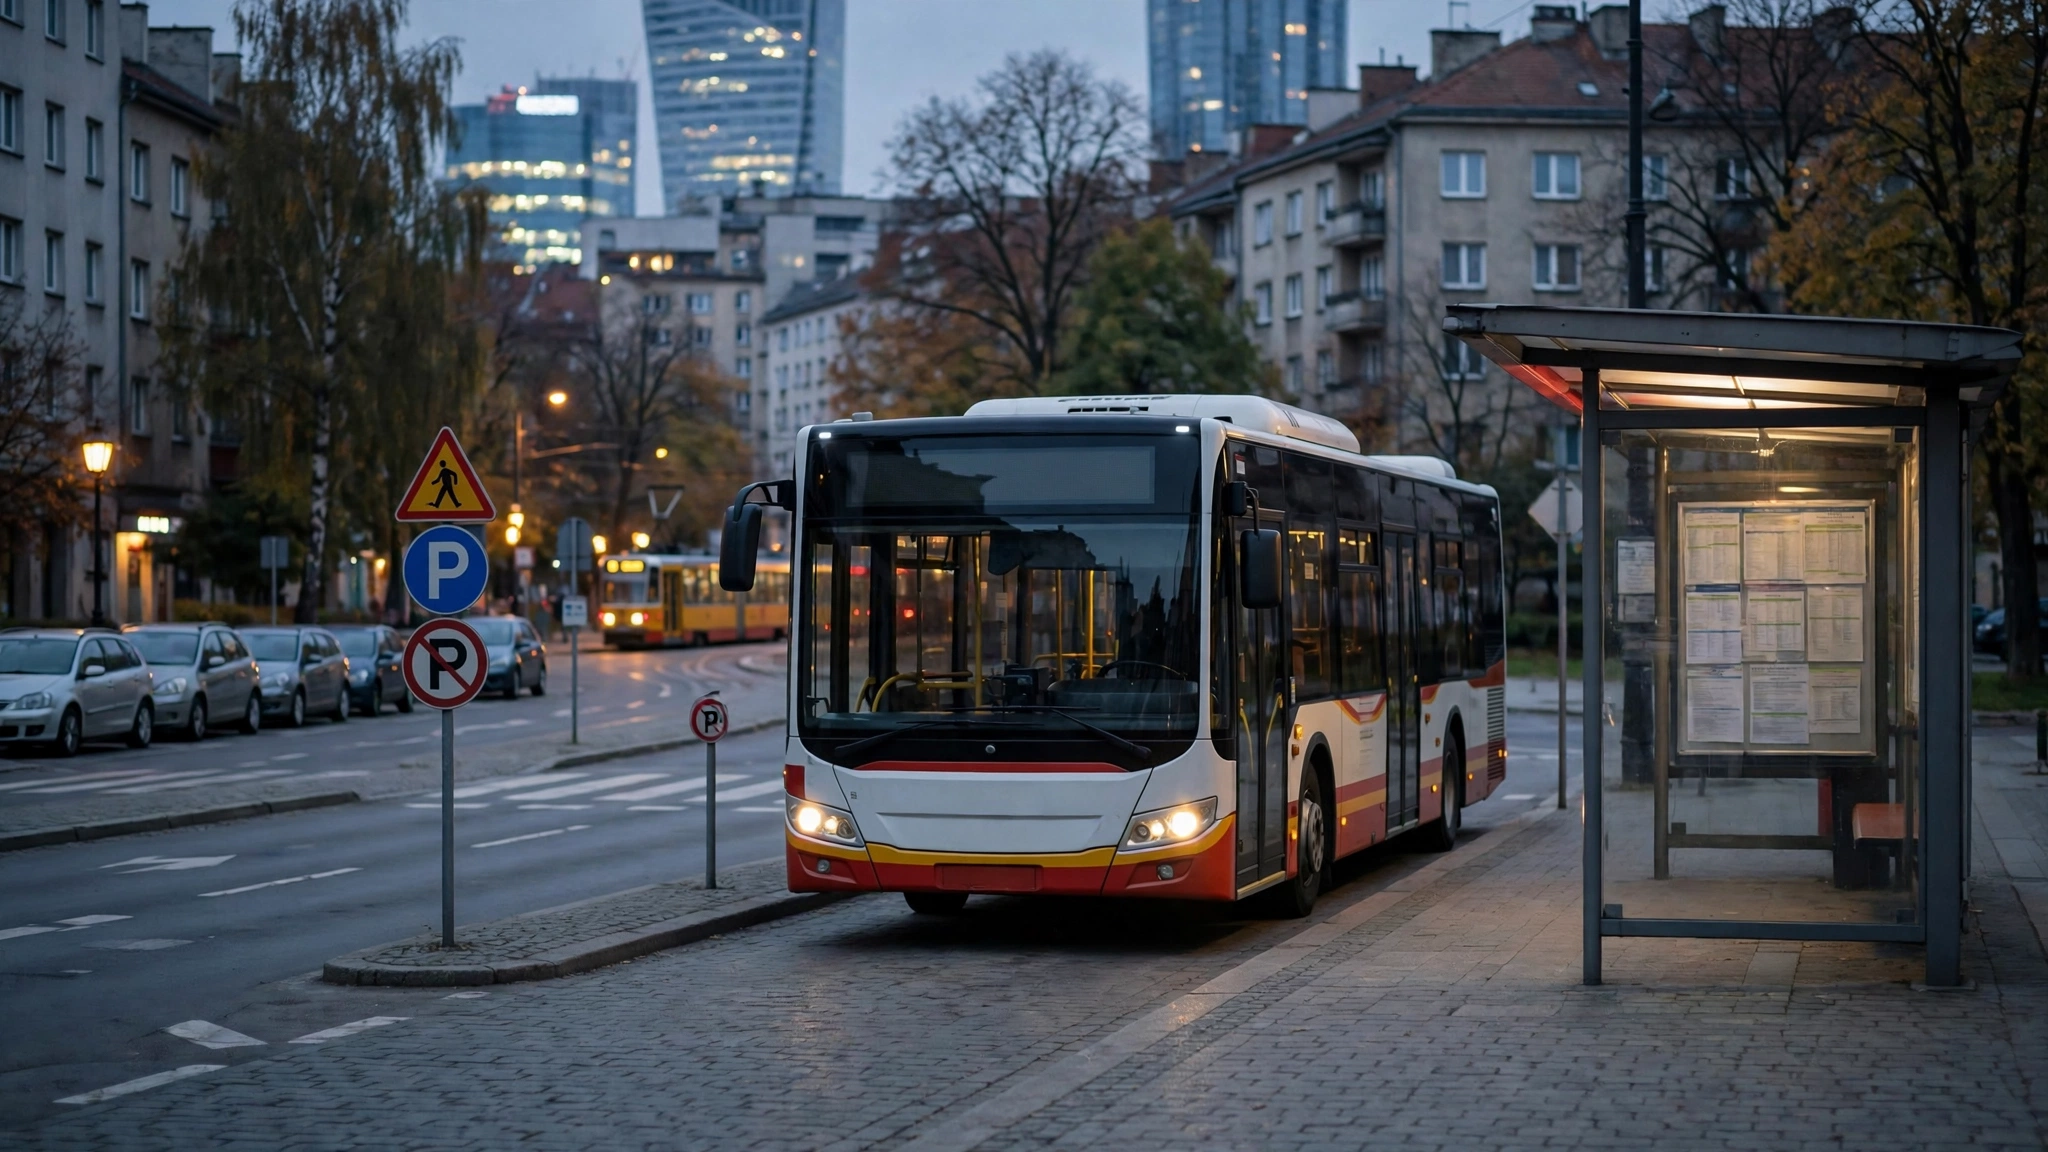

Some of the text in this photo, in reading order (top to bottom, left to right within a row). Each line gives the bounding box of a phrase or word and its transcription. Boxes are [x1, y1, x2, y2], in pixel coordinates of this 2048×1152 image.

[428, 541, 469, 599] P
[429, 638, 467, 690] P
[703, 711, 718, 733] P
